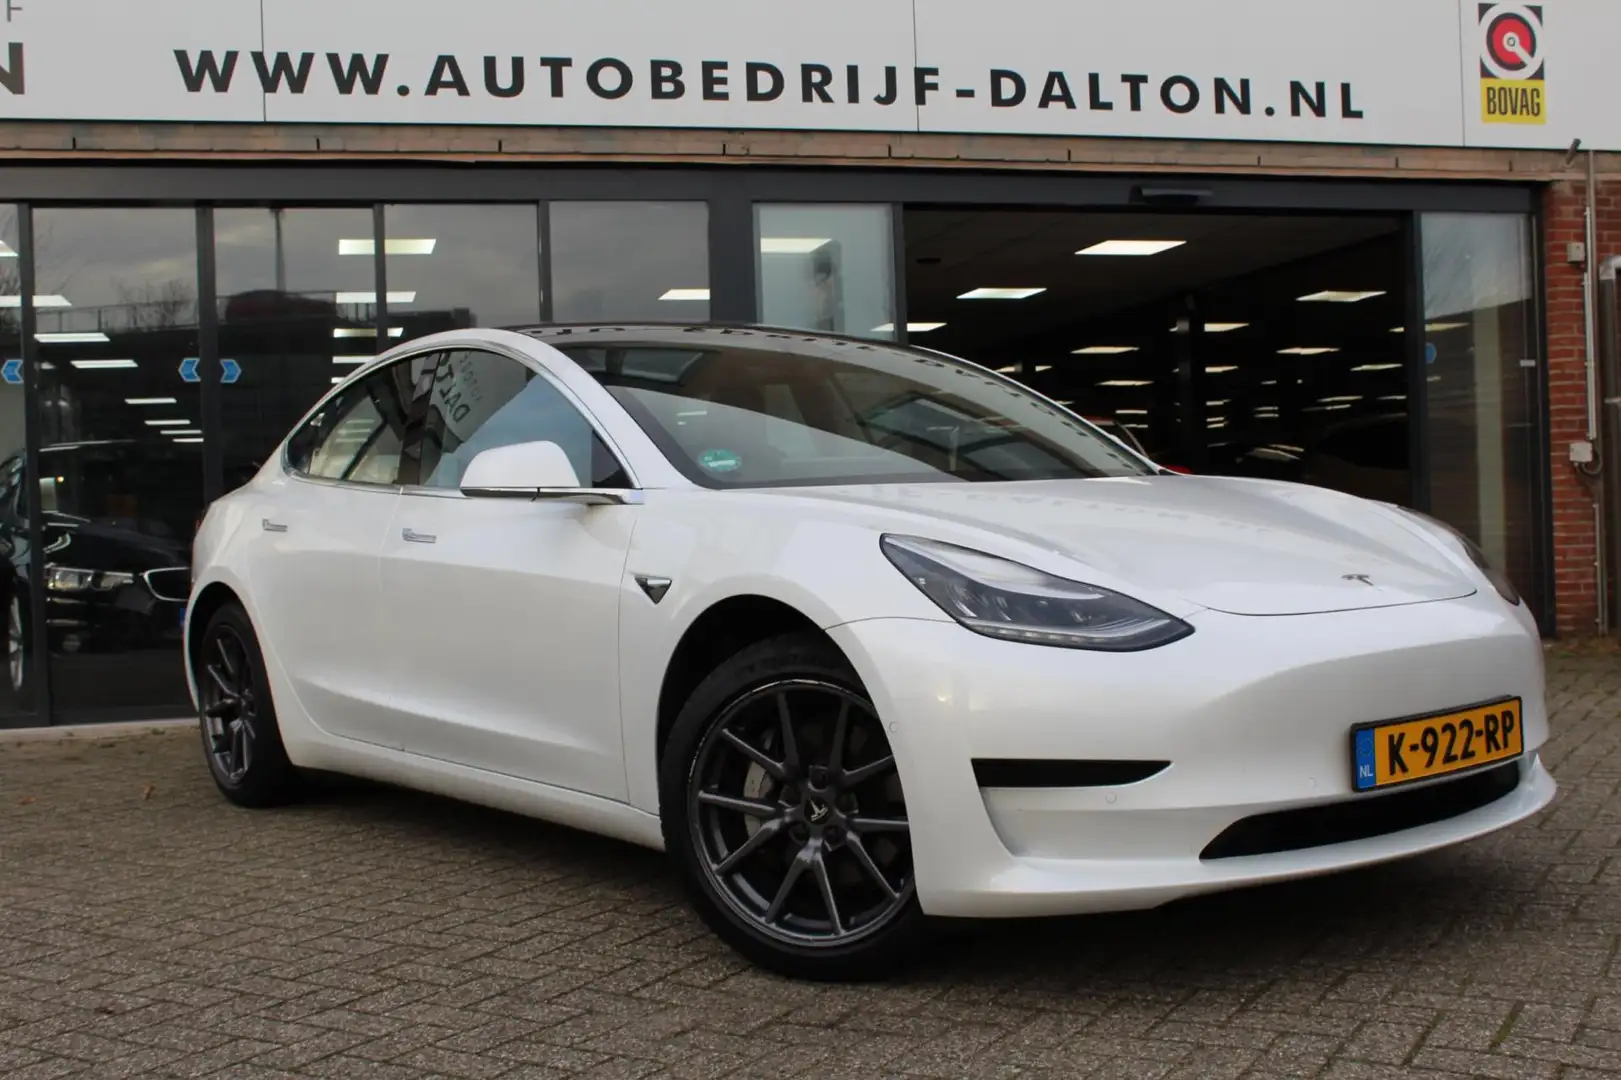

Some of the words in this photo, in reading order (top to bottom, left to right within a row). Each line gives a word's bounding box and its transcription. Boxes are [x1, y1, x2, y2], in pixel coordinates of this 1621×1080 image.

[174, 49, 1364, 118] WWW.AUTOBEDRIJF-DALTON.NL
[1486, 86, 1541, 117] BOVAG
[1359, 765, 1373, 778] NL
[1387, 710, 1515, 776] K-922-RP
